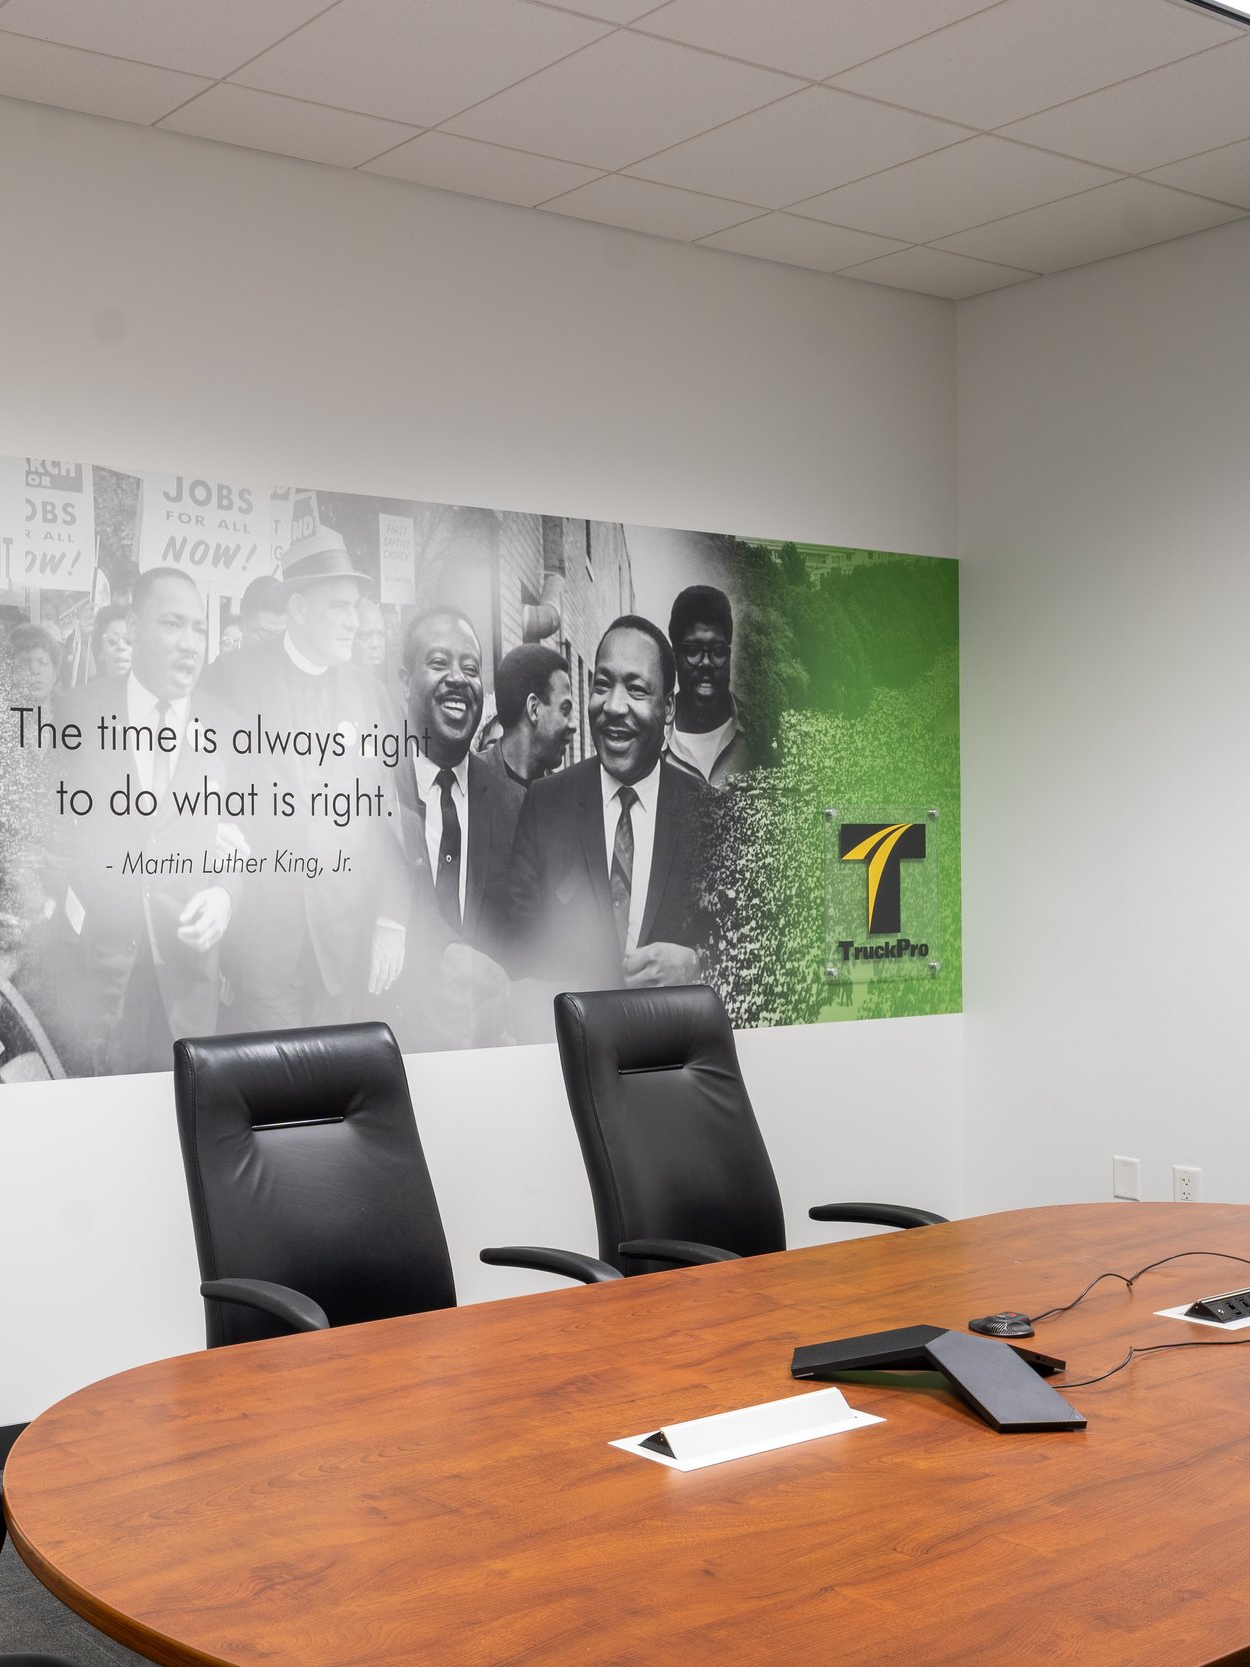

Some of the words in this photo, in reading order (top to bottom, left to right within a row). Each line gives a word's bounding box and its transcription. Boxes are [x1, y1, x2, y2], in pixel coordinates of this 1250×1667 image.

[25, 458, 76, 477] RCH
[162, 476, 254, 515] JOBS
[165, 510, 206, 527] FOR
[217, 519, 251, 534] ALL
[386, 523, 408, 537] FIRST
[43, 531, 75, 543] ALL
[383, 536, 411, 550] BAPTIST
[162, 535, 257, 572] NOW!
[383, 550, 410, 562] CHURCH
[10, 706, 82, 751] The
[97, 714, 178, 753] time
[193, 717, 217, 754] is
[232, 714, 346, 766] always
[360, 719, 432, 768] right
[56, 780, 94, 816] to
[109, 773, 158, 817] do
[172, 775, 259, 817] what
[273, 782, 296, 817] is
[310, 778, 393, 827] right.
[122, 850, 193, 875] Martin
[202, 850, 267, 874] Luther
[273, 849, 325, 879] King,
[332, 850, 353, 873] Jr.
[838, 939, 929, 961] TruckPro
